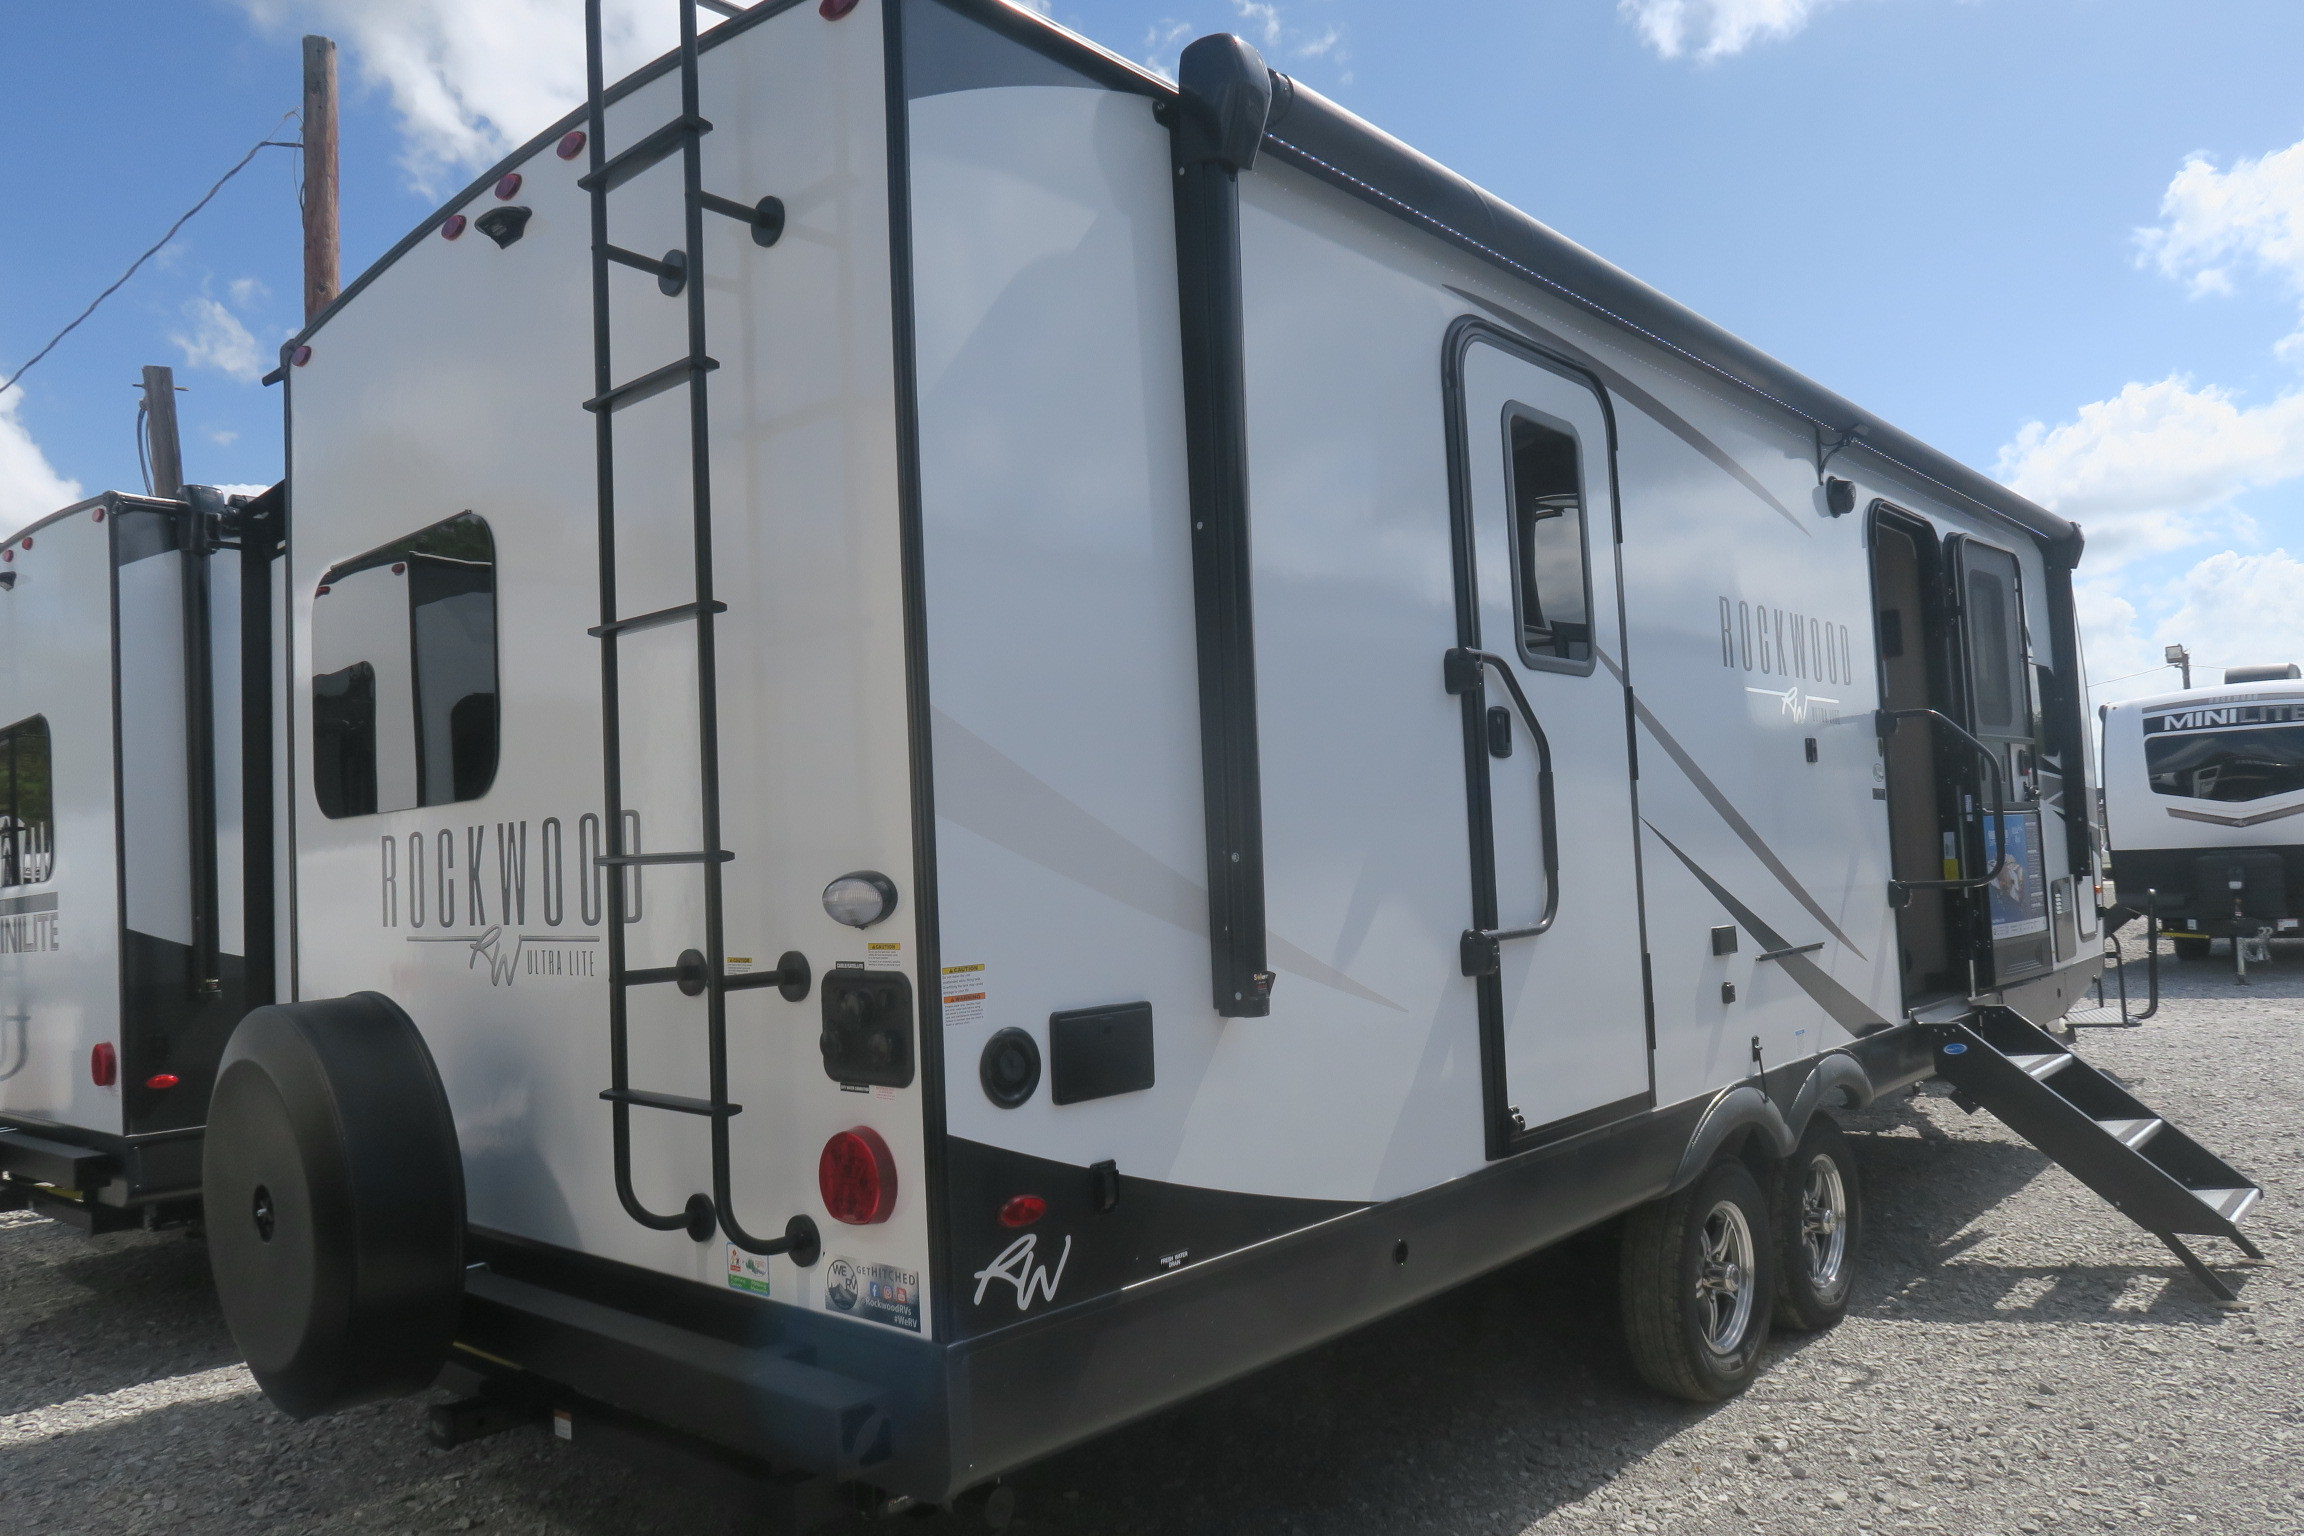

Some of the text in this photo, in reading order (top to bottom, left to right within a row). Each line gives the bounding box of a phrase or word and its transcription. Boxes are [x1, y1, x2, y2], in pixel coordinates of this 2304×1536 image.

[1719, 596, 1851, 685] ROCKWOOD
[381, 809, 643, 929] ROCKWOOD
[527, 949, 595, 977] ULTRA LITE
[953, 965, 979, 973] CAUTION
[1160, 1250, 1188, 1265] FRESH WATER
[1168, 1259, 1181, 1268] DRAIN
[833, 1264, 847, 1277] WE
